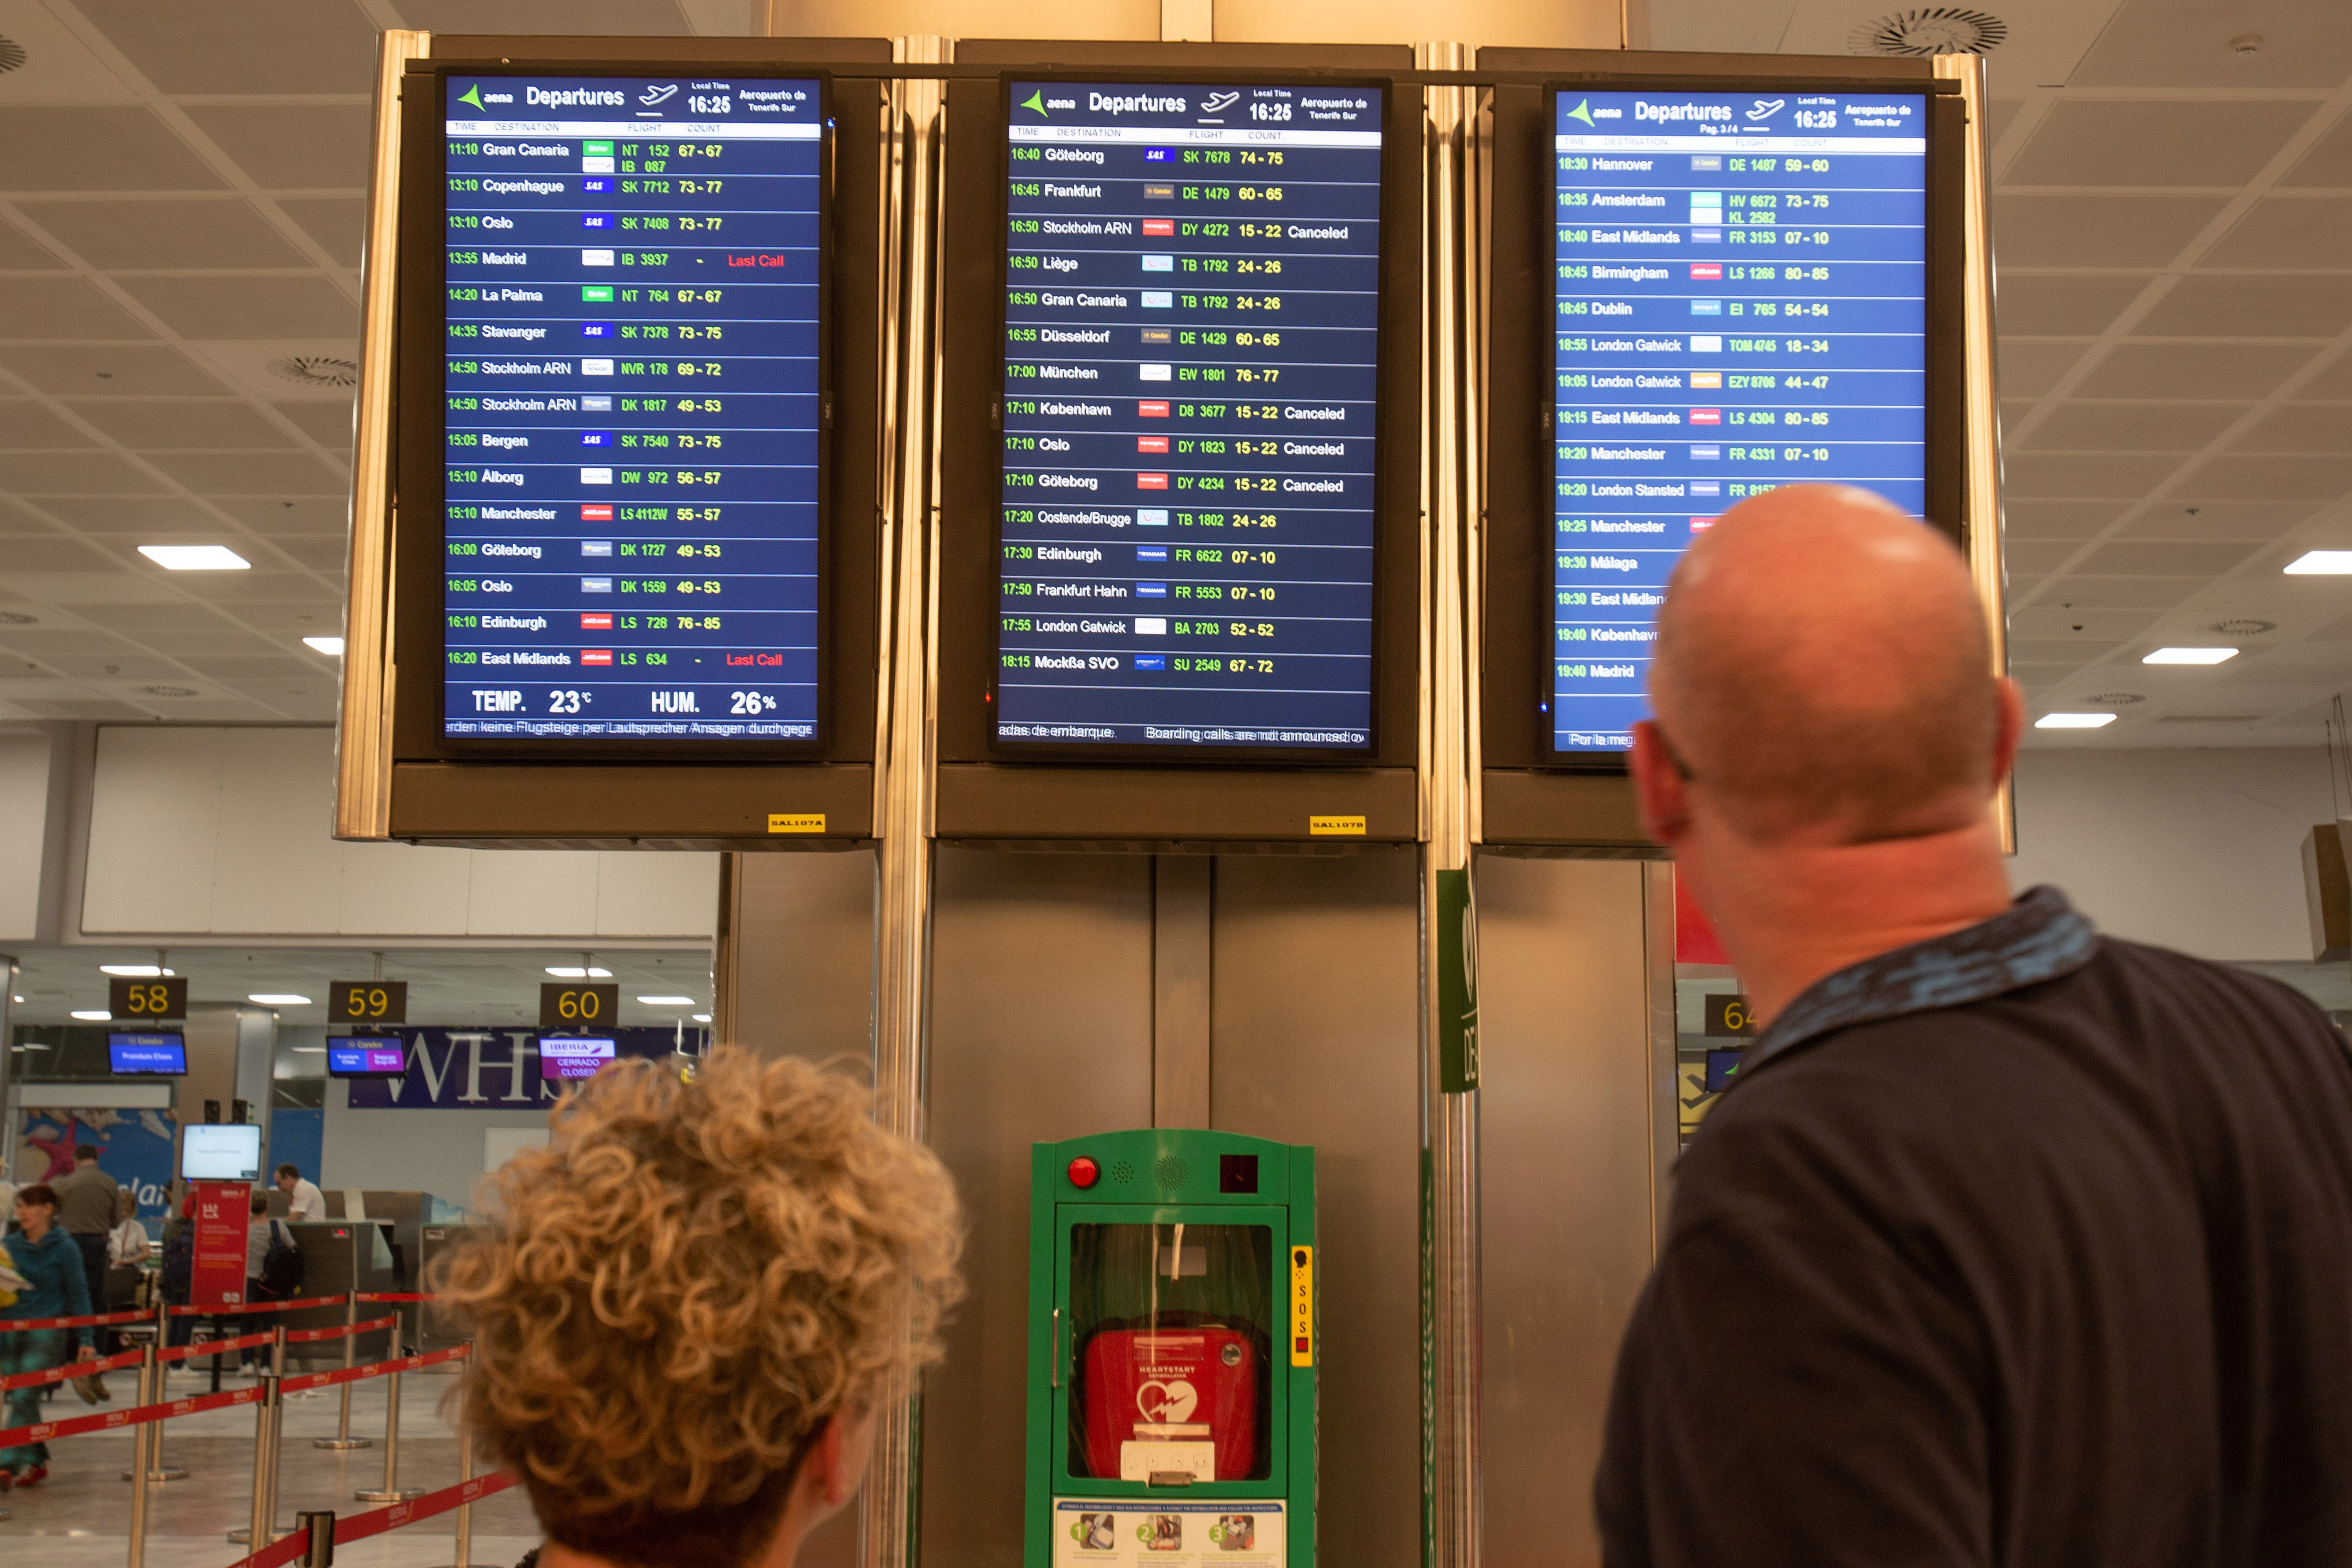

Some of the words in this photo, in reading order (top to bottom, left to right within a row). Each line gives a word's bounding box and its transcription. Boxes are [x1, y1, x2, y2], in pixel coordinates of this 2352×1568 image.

[484, 94, 513, 103] aena
[527, 87, 624, 109] Departures
[688, 96, 730, 113] 16:25
[739, 90, 792, 101] Aeropuerto
[794, 90, 806, 100] de
[1047, 100, 1075, 109] aena
[1089, 93, 1186, 115] Departures
[1250, 103, 1291, 120] 16:25
[1301, 98, 1353, 109] Aeropuerto
[1356, 98, 1367, 108] de
[1309, 111, 1341, 119] Tenerife
[1593, 109, 1622, 118] aena
[1635, 101, 1731, 124] Departures
[1794, 111, 1836, 128] 16:25
[1845, 105, 1897, 117] Aeropuerto
[1898, 105, 1911, 115] de
[495, 123, 559, 132] DESTINATION
[628, 124, 662, 132] FLIGHT
[687, 124, 724, 133] COUNT.
[1700, 124, 1719, 135] Pag.
[1853, 118, 1885, 126] Tenerife
[1017, 128, 1039, 136] TIME
[1057, 128, 1121, 137] DESTINATION
[1189, 130, 1224, 139] FLIGHT
[1248, 131, 1285, 140] COUNT.
[449, 143, 478, 155] 11:10
[483, 143, 515, 155] Gran
[519, 144, 569, 156] Canaria
[623, 144, 639, 156] NT
[649, 144, 669, 156] 152
[1012, 148, 1040, 160] 16:40
[1045, 148, 1104, 164] Göteborg
[1184, 151, 1199, 163] SK
[1205, 151, 1230, 163] 7678
[622, 161, 635, 172] IB
[645, 161, 666, 172] 087
[449, 179, 478, 191] 13:10
[483, 180, 564, 195] Copenhague
[622, 181, 638, 193] SK
[643, 181, 669, 193] 7712
[1559, 193, 1588, 205] 18:35
[1592, 193, 1665, 206] Amsterdam
[1730, 195, 1746, 207] HV
[1750, 195, 1776, 207] 6672
[1010, 220, 1039, 232] 16:50
[1043, 221, 1101, 234] Stockholm
[1104, 222, 1131, 234] ARN
[1182, 223, 1198, 235] DY
[1203, 224, 1229, 236] 4272
[1288, 226, 1348, 239] Canceled
[449, 252, 478, 264] 13:55
[482, 252, 526, 264] Madrid
[622, 253, 634, 265] IB
[640, 253, 668, 265] 3937
[728, 254, 755, 267] Last
[759, 255, 784, 267] Call
[1559, 302, 1587, 314] 18:45
[1592, 302, 1632, 315] Dublin
[1730, 303, 1743, 316] EI
[1753, 303, 1776, 316] 765
[1008, 329, 1036, 341] 16:55
[1042, 329, 1111, 343] Düsseldorf
[1180, 332, 1196, 344] DE
[1202, 332, 1227, 344] 1429
[1558, 375, 1587, 387] 19:05
[1592, 375, 1633, 387] London
[1635, 375, 1681, 388] Gatwick
[1729, 376, 1750, 388] EZY
[1751, 376, 1775, 388] 8706
[1007, 402, 1035, 414] 17:10
[1040, 402, 1111, 415] København
[1179, 405, 1194, 416] D8
[1200, 405, 1226, 417] 3677
[1285, 407, 1345, 419] Canceled
[448, 471, 477, 482] 15:10
[482, 469, 523, 485] Ålborg
[621, 472, 640, 483] DW
[648, 472, 668, 483] 972
[1558, 483, 1587, 495] 19:20
[1592, 484, 1633, 496] London
[1635, 484, 1684, 496] Stansted
[448, 507, 477, 519] 15:10
[482, 507, 556, 519] Manchester
[621, 508, 634, 520] LS
[635, 508, 667, 520] 4112W
[1004, 510, 1033, 522] 17:20
[1038, 511, 1131, 527] Oostende/Brugge
[1177, 514, 1192, 525] TB
[1199, 514, 1224, 526] 1802
[1558, 556, 1587, 568] 19:30
[1591, 556, 1638, 572] Málaga
[1557, 593, 1587, 604] 19:30
[1591, 593, 1620, 605] East
[1623, 593, 1669, 605] Midlan
[1003, 619, 1031, 631] 17:55
[1037, 620, 1078, 632] London
[1081, 621, 1126, 633] Gatwick
[1175, 622, 1190, 634] BA
[1195, 623, 1219, 634] 2703
[1557, 629, 1587, 640] 19:40
[448, 652, 476, 664] 16:20
[482, 652, 511, 664] East
[514, 653, 571, 664] Midlands
[621, 653, 637, 664] LS
[646, 653, 667, 664] 634
[727, 654, 754, 665] Last
[757, 653, 782, 666] Call
[1002, 656, 1030, 667] 18:15
[1089, 657, 1119, 669] SVO
[1174, 659, 1190, 670] SU
[1195, 659, 1221, 671] 2549
[472, 691, 526, 711] TEMP.
[652, 691, 700, 713] HUM.
[128, 985, 169, 1013] 58
[347, 989, 387, 1016] 59
[558, 991, 599, 1019] 60
[357, 1040, 383, 1049] Condor
[557, 1059, 600, 1067] CERRADO
[561, 1068, 596, 1076] CLOSED
[1074, 1527, 1083, 1538] 1
[1140, 1527, 1150, 1539] 2
[1213, 1527, 1222, 1539] 3
